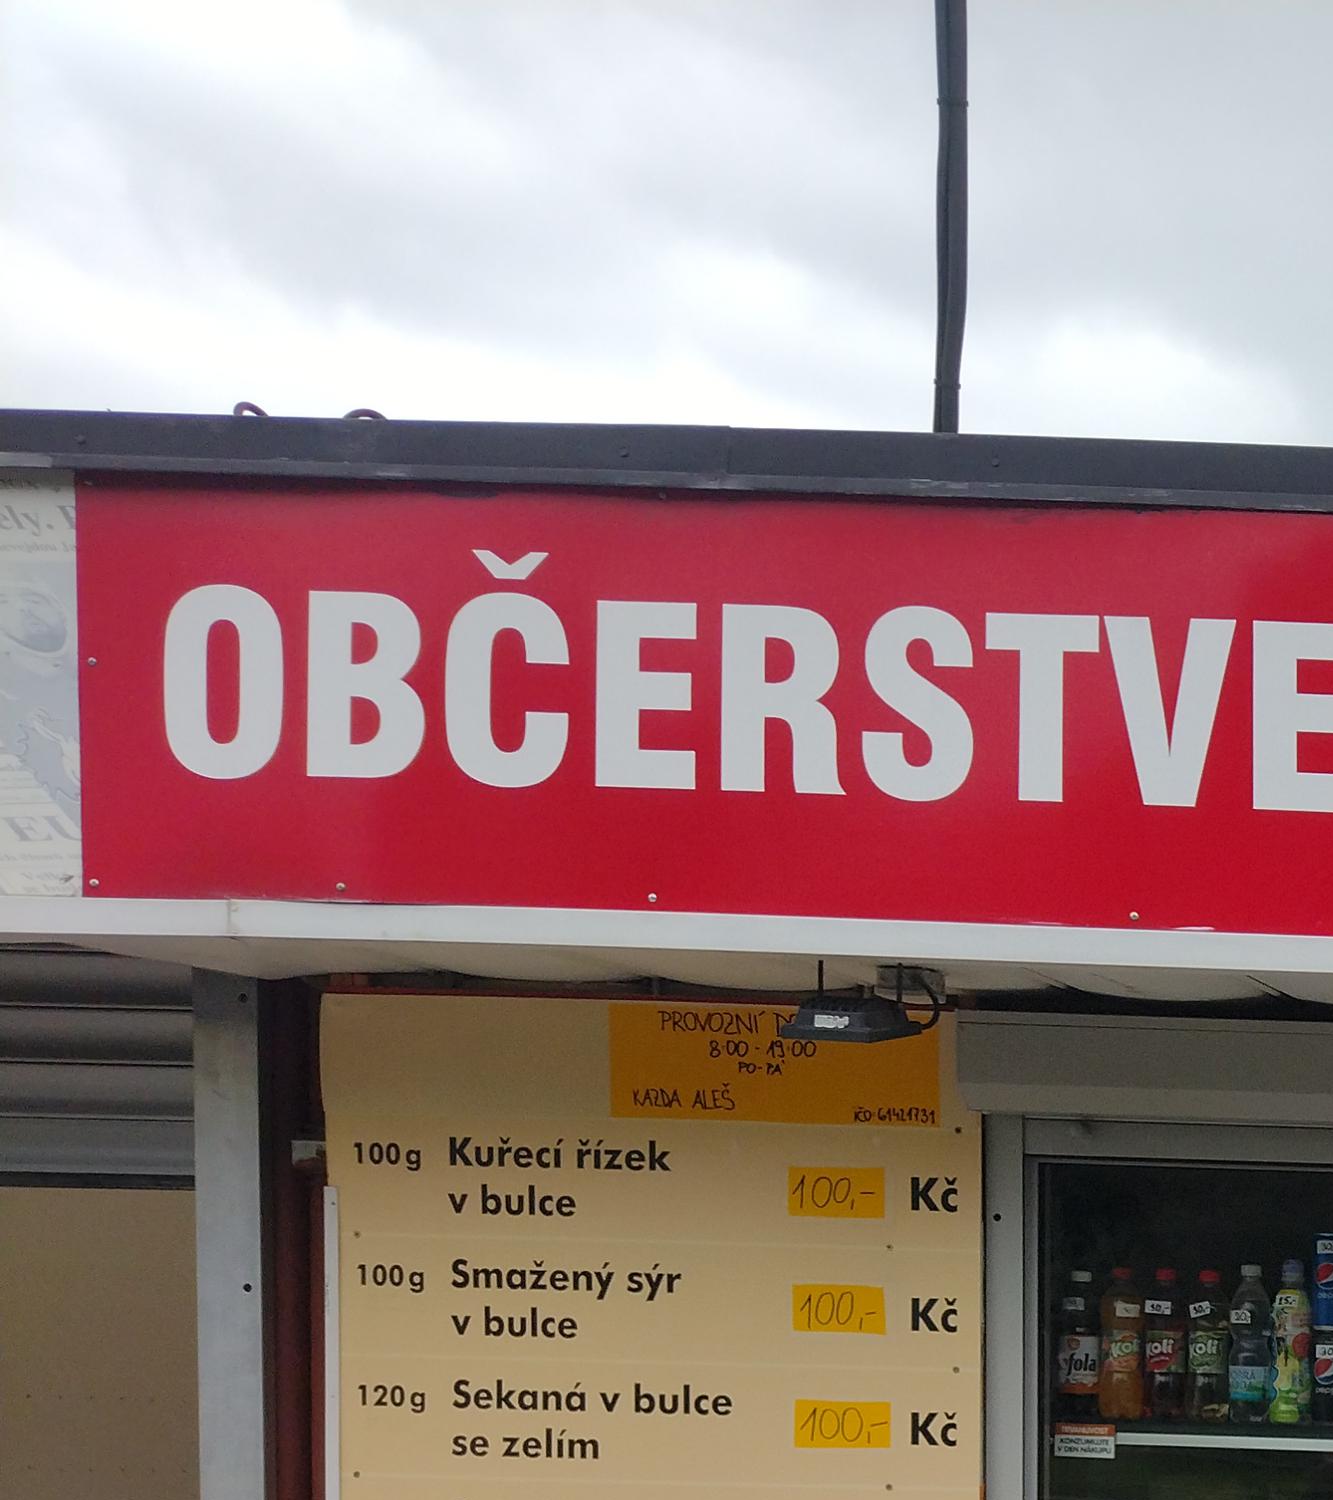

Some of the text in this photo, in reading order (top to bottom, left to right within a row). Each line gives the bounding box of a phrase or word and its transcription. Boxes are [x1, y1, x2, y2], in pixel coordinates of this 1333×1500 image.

[657, 1010, 765, 1036] PROVOZNÍ
[691, 1082, 736, 1110] ALEŠ
[449, 1136, 563, 1168] Kuřecí
[577, 1139, 671, 1172] řízek
[448, 1184, 576, 1218] v bulce
[911, 1177, 958, 1213] Kč
[451, 1259, 615, 1301] Smažený
[627, 1264, 682, 1302] sýr
[451, 1306, 578, 1339] v bulce
[911, 1298, 958, 1334] Kč
[453, 1379, 587, 1412] Sekaná
[600, 1393, 620, 1413] v
[634, 1383, 733, 1416] bulce
[452, 1428, 600, 1460] se zelím
[911, 1412, 958, 1447] Kč
